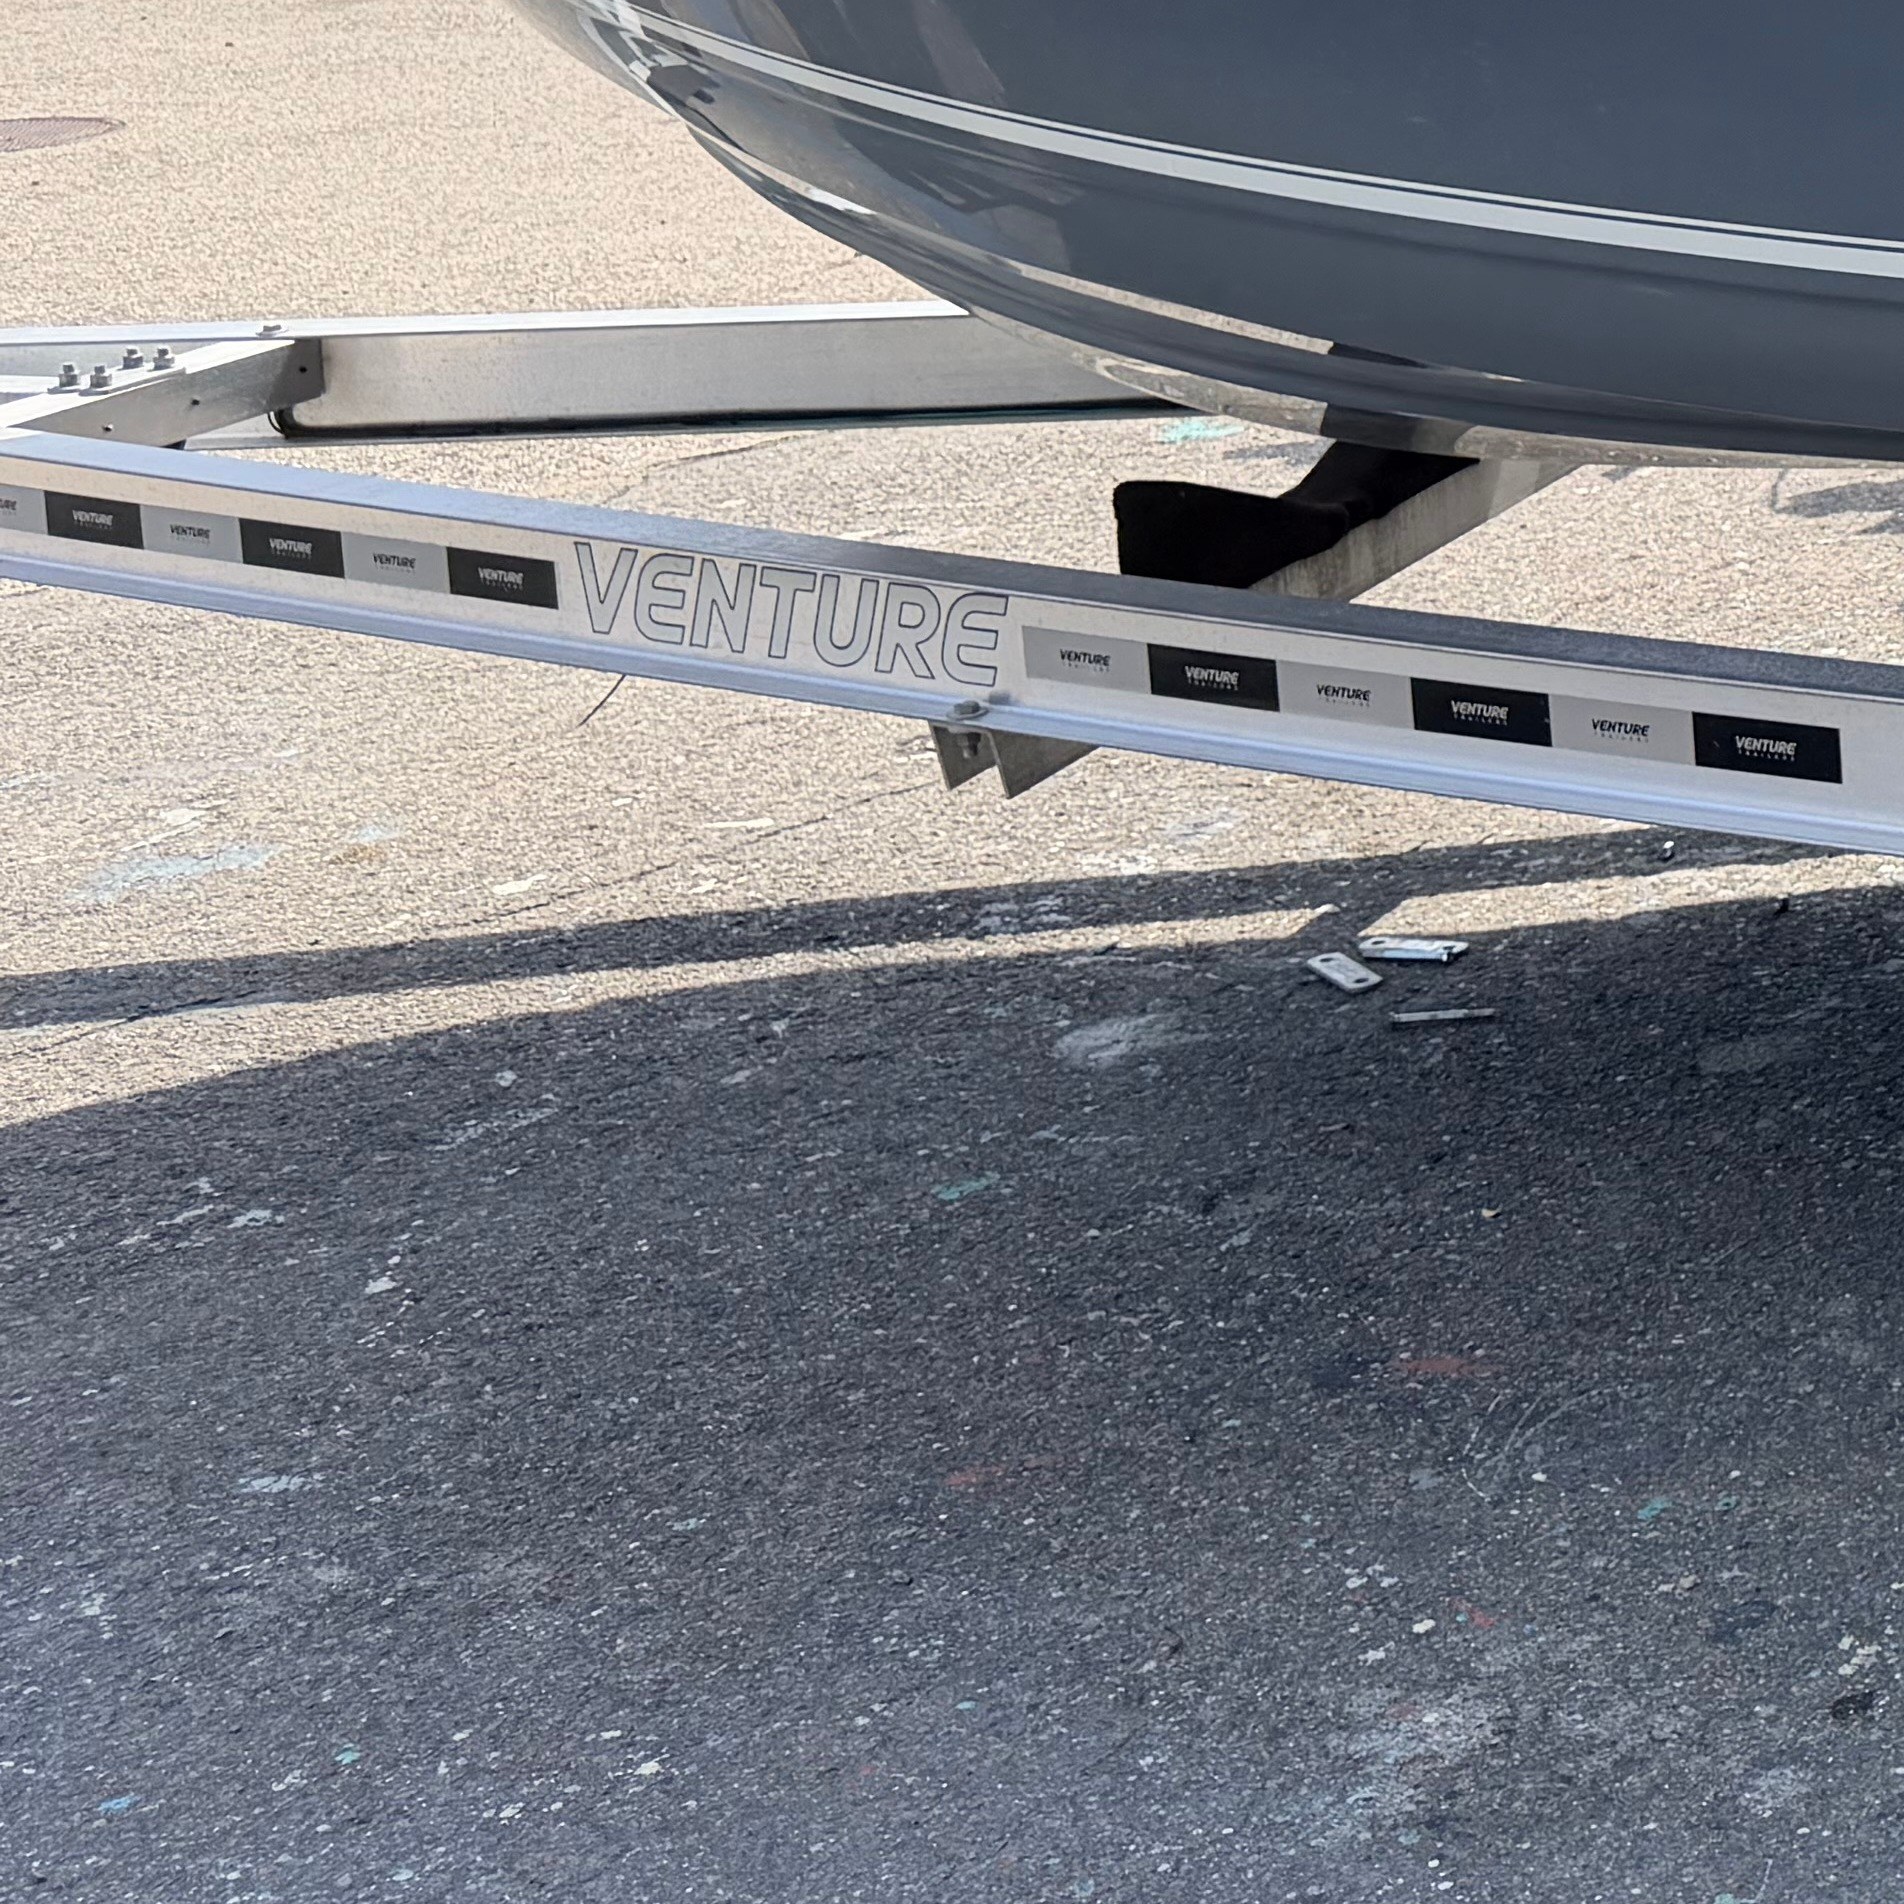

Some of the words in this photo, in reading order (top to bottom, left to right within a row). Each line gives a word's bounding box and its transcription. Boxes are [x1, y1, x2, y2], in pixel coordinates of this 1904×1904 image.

[573, 541, 1010, 687] VENTURE
[1184, 665, 1239, 685] VENTURE
[1316, 684, 1371, 701] VENTURE
[1451, 699, 1509, 719] VENTURE
[1591, 718, 1650, 737] VENTURE
[1735, 735, 1797, 755] VENTURE
